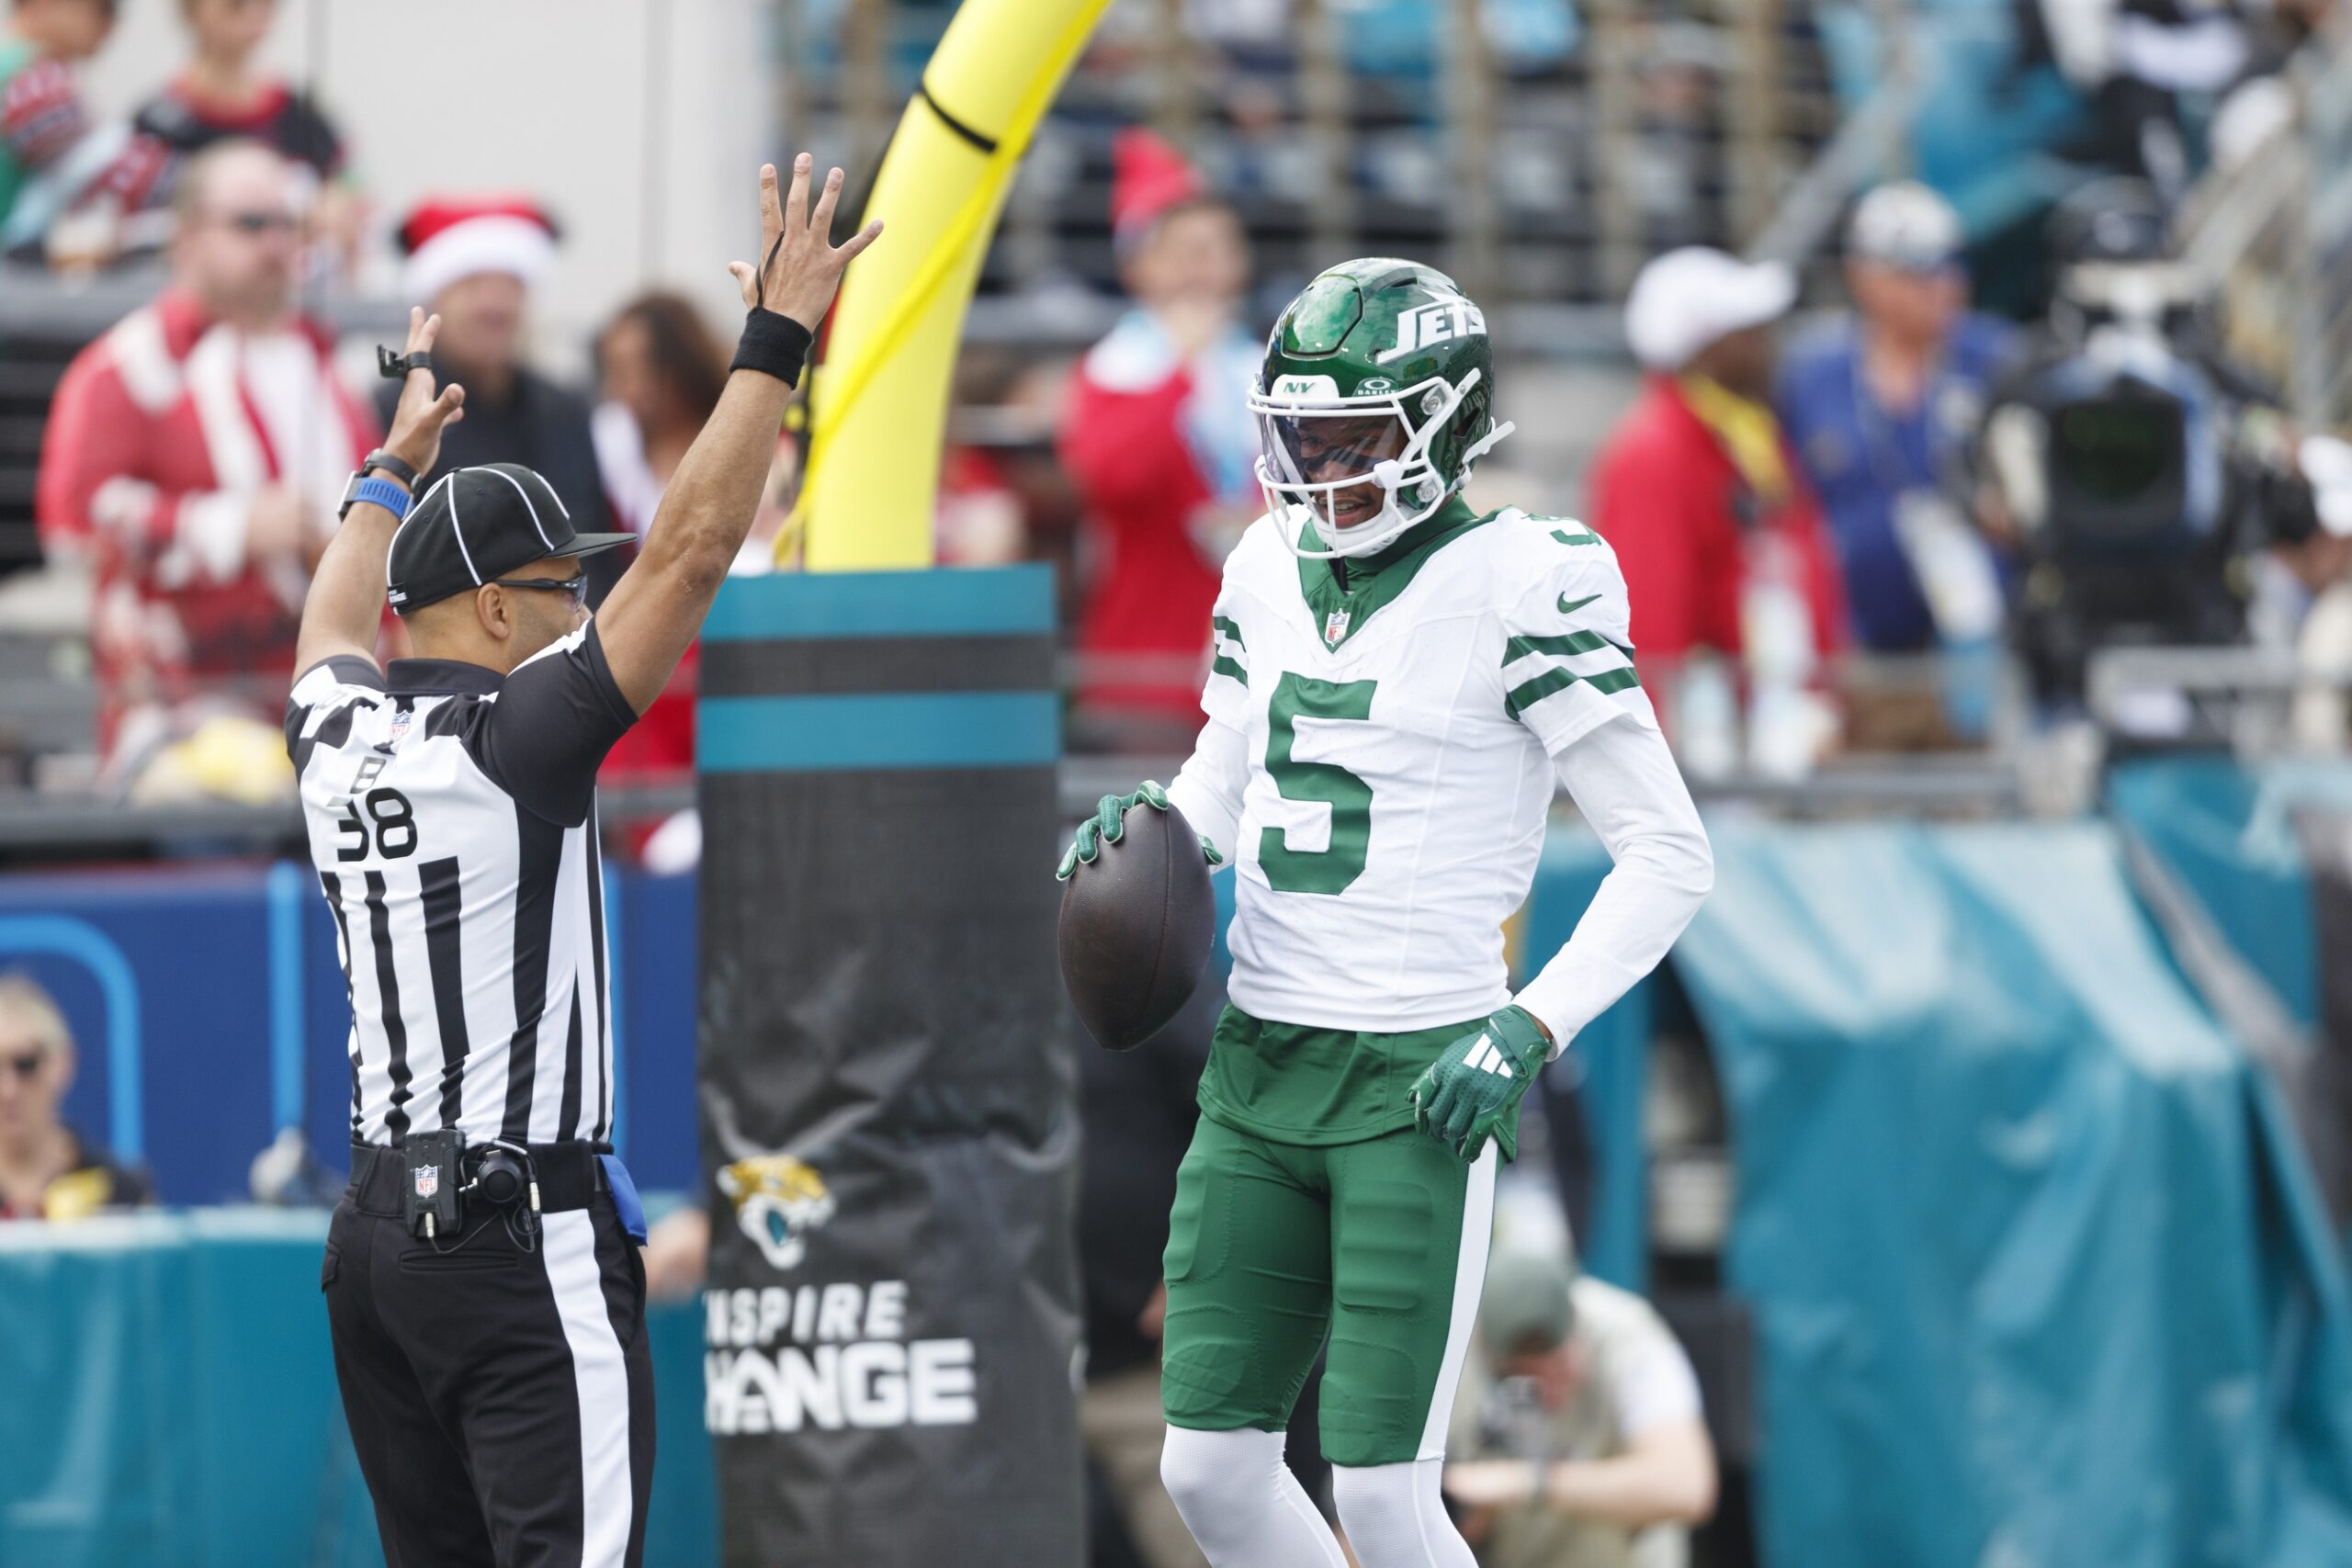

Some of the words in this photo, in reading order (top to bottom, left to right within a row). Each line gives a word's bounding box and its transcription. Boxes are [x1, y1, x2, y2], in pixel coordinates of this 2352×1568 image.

[1377, 297, 1487, 364] JETS
[1283, 381, 1316, 393] NY
[1258, 671, 1378, 896] 5
[326, 787, 418, 862] 38
[703, 1280, 908, 1345] NSPIRE
[704, 1337, 977, 1435] HANGE
